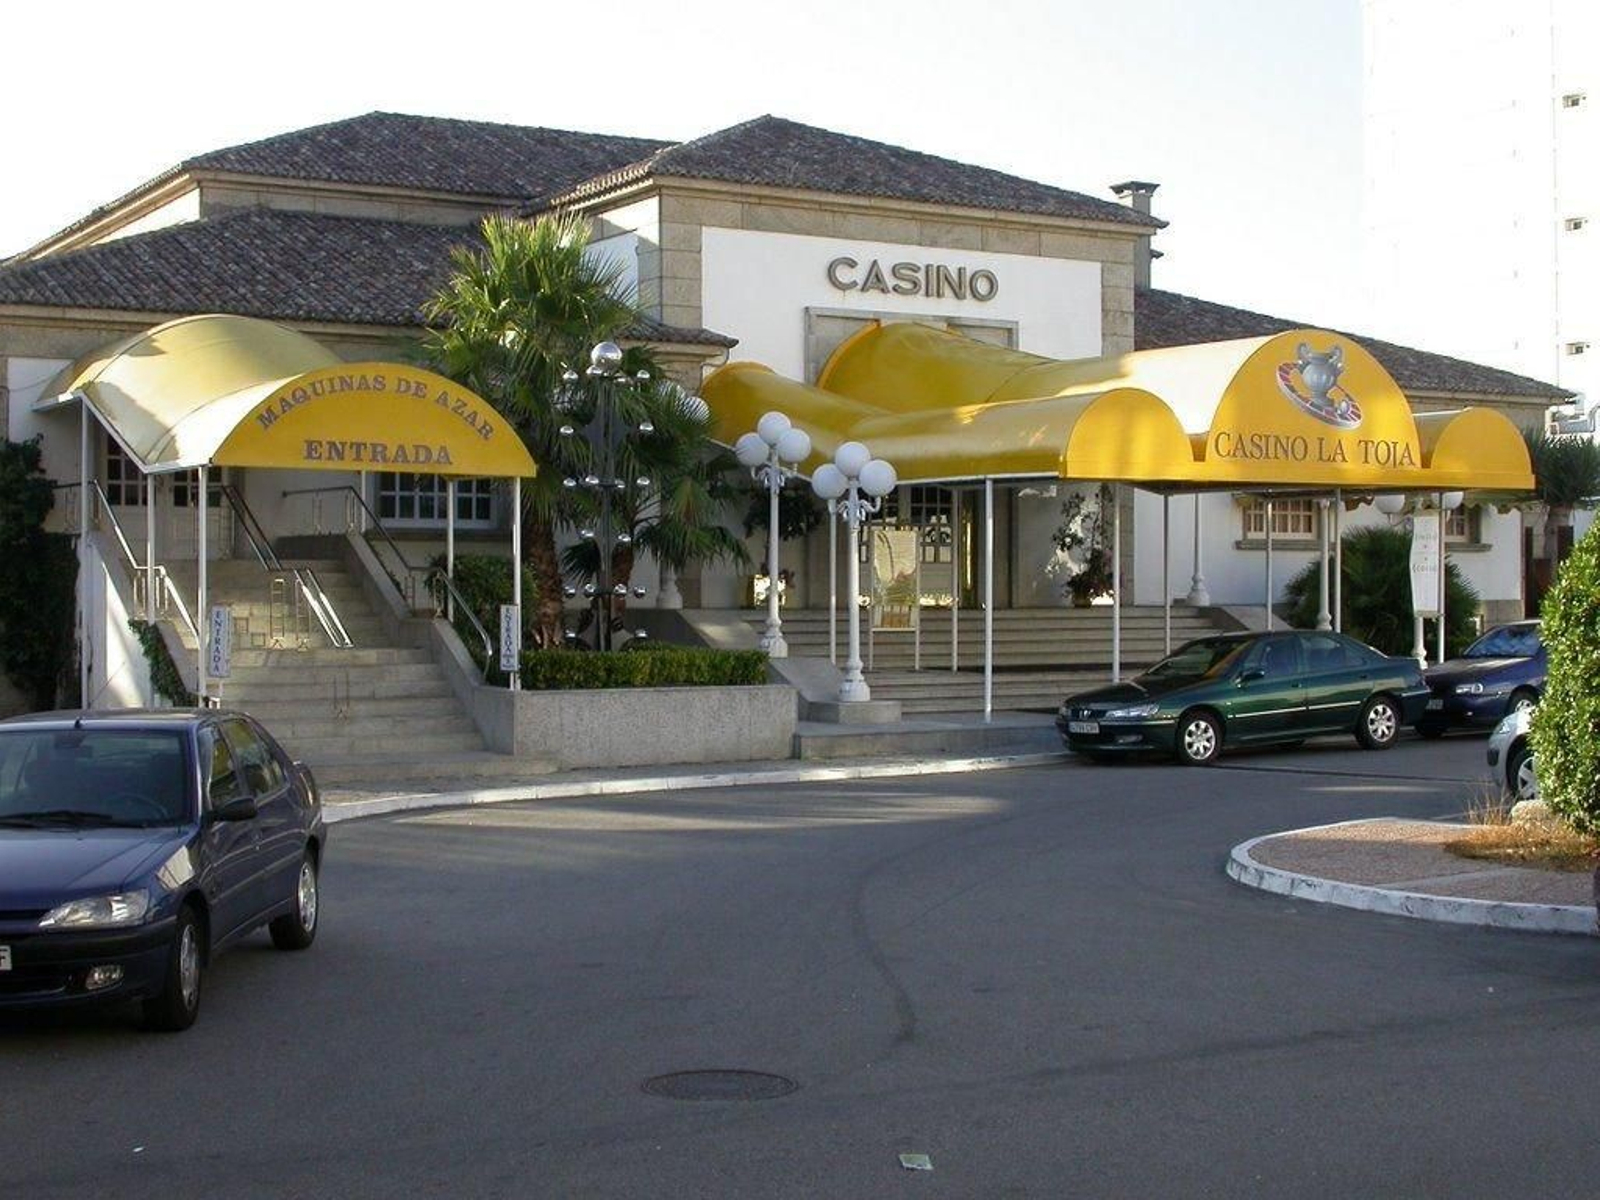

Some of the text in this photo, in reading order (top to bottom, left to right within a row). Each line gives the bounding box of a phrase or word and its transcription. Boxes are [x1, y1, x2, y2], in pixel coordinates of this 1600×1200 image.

[827, 256, 999, 301] CASINO
[258, 374, 495, 442] MAQUINAS DE AZAR
[303, 438, 453, 465] ENTRADA
[1214, 431, 1416, 469] CASINO LA TOJA
